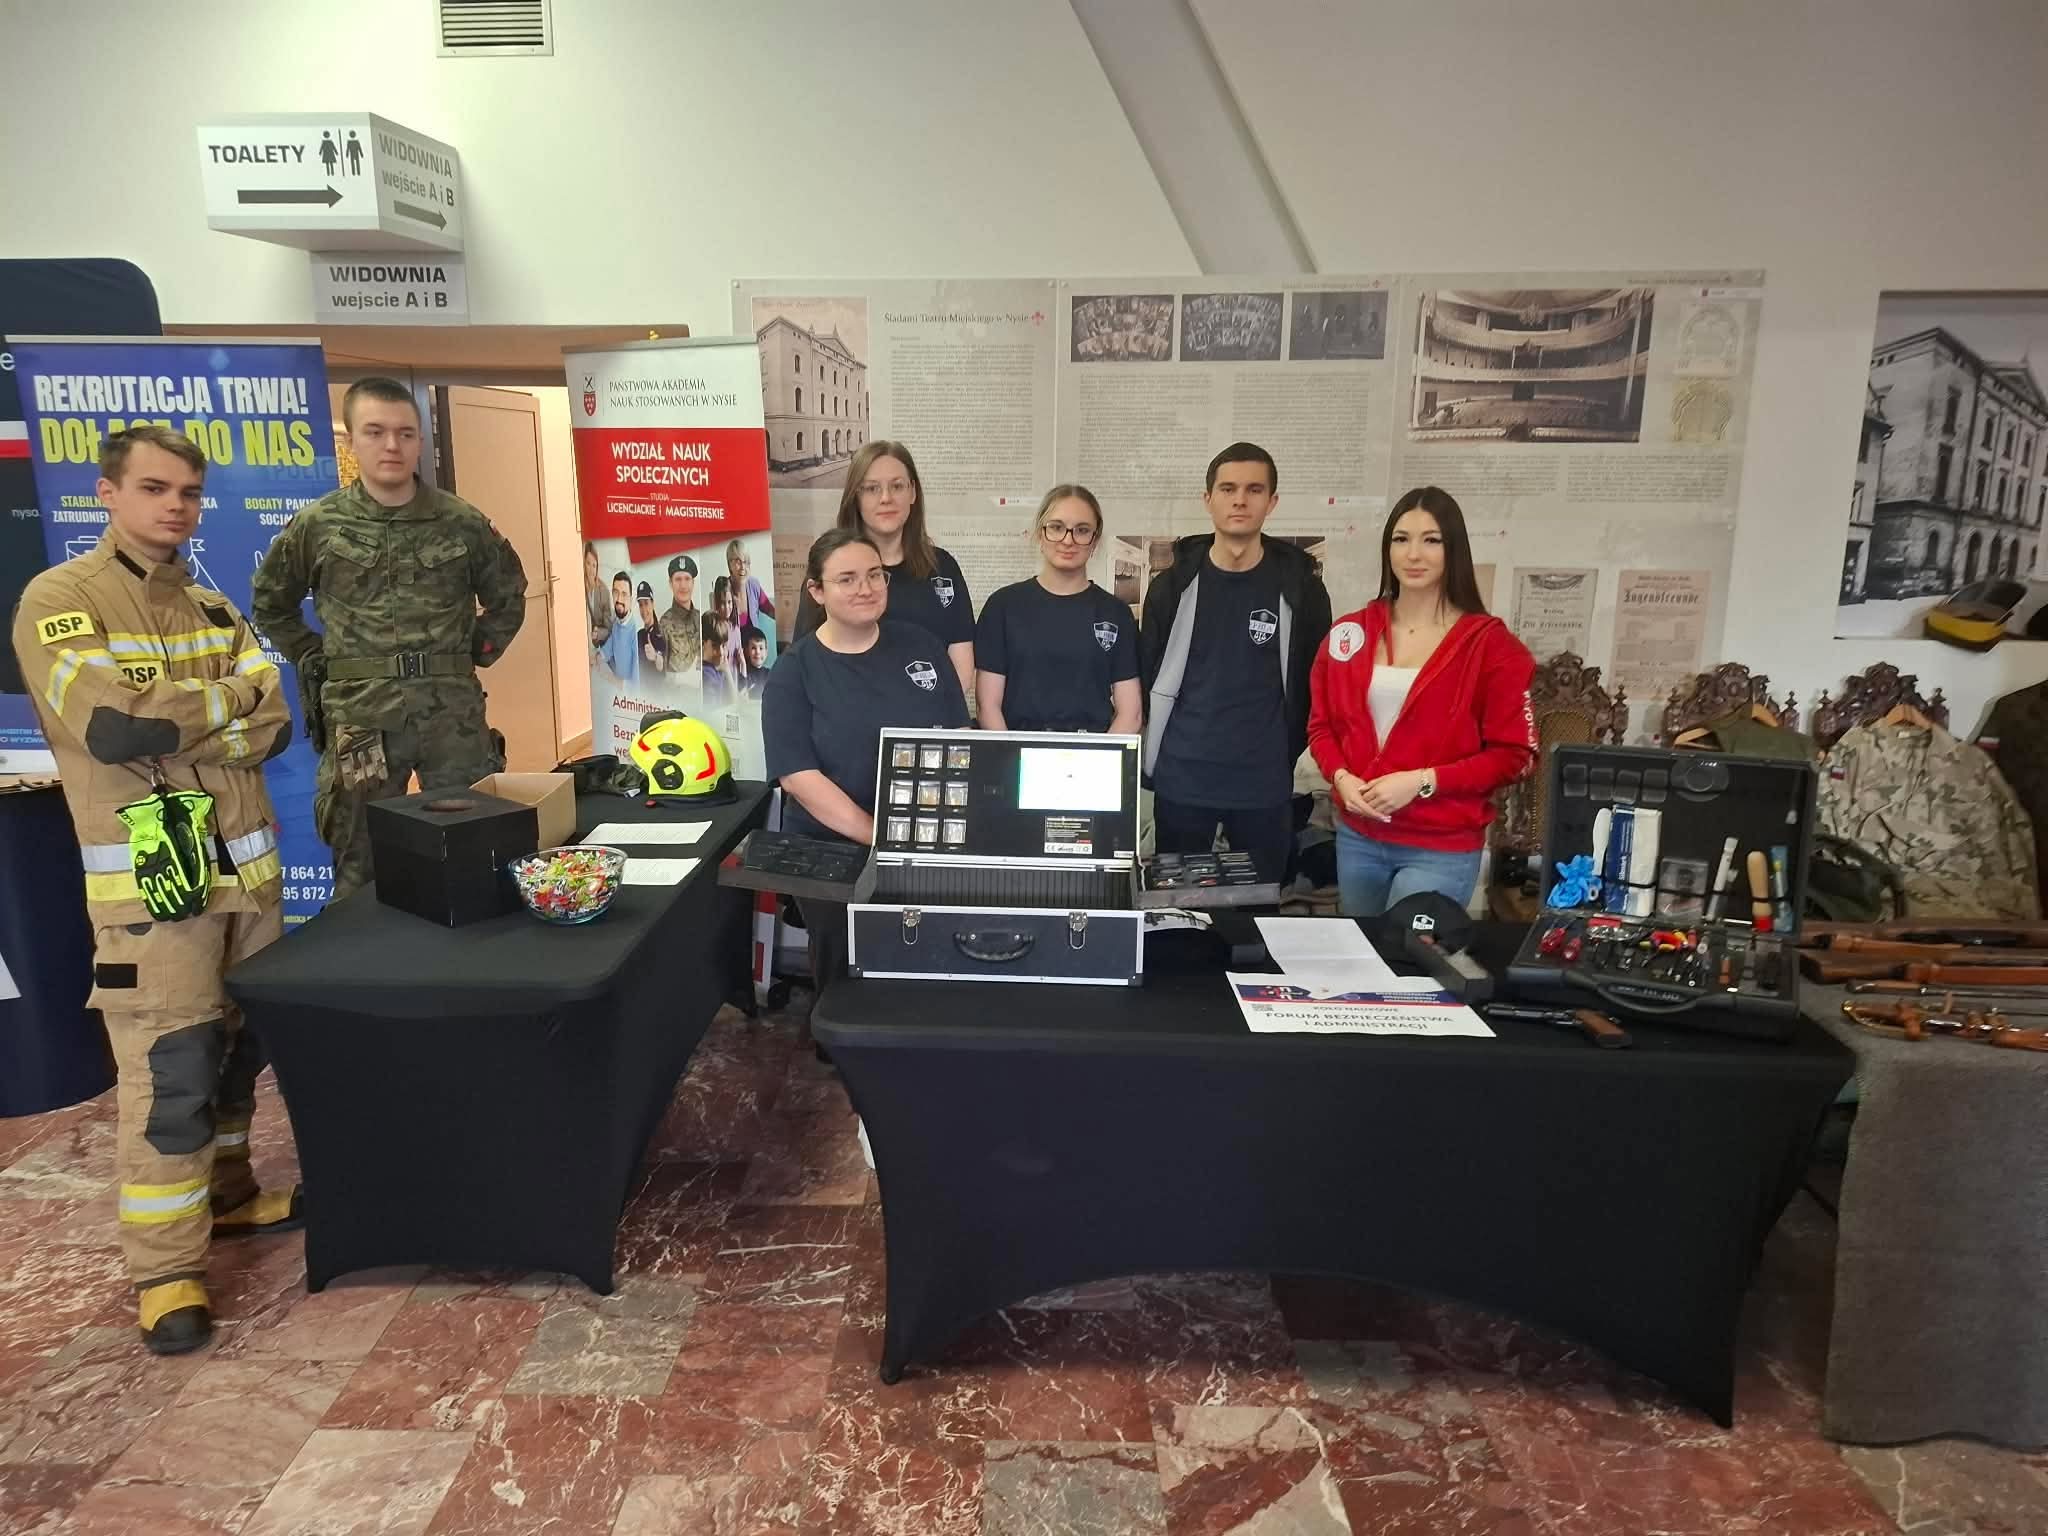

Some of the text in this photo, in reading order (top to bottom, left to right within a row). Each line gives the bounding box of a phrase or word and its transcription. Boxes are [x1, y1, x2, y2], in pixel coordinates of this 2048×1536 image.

[208, 145, 305, 164] TOALETY
[378, 133, 453, 179] WIDOWNIA
[382, 168, 426, 198] wejście
[429, 185, 438, 200] A
[446, 187, 455, 207] B
[329, 266, 447, 283] WIDOWNIA
[332, 291, 448, 310] wejscie A i B
[609, 378, 706, 392] PAŃSTWOWA AKADEMIA
[33, 375, 310, 415] REKRUTACJA TRWA!
[610, 393, 738, 408] NAUK STOSOWANYCH W NYSIE
[242, 421, 316, 467] NAS
[611, 442, 711, 462] WYDZIAŁ NAUK
[615, 465, 709, 486] SPOŁECZNYCH
[244, 497, 283, 510] BOGATY
[607, 502, 656, 516] LICENCJACKIE
[665, 506, 725, 520] MAGISTERSKIE
[44, 615, 84, 638] OSP
[122, 666, 157, 684] OSP
[290, 866, 316, 880] 864
[302, 886, 327, 900] 872
[1265, 1012, 1456, 1022] FORUM BEZPIECZEŃSTWA
[1310, 1021, 1428, 1030] ADMINISTRACJI
